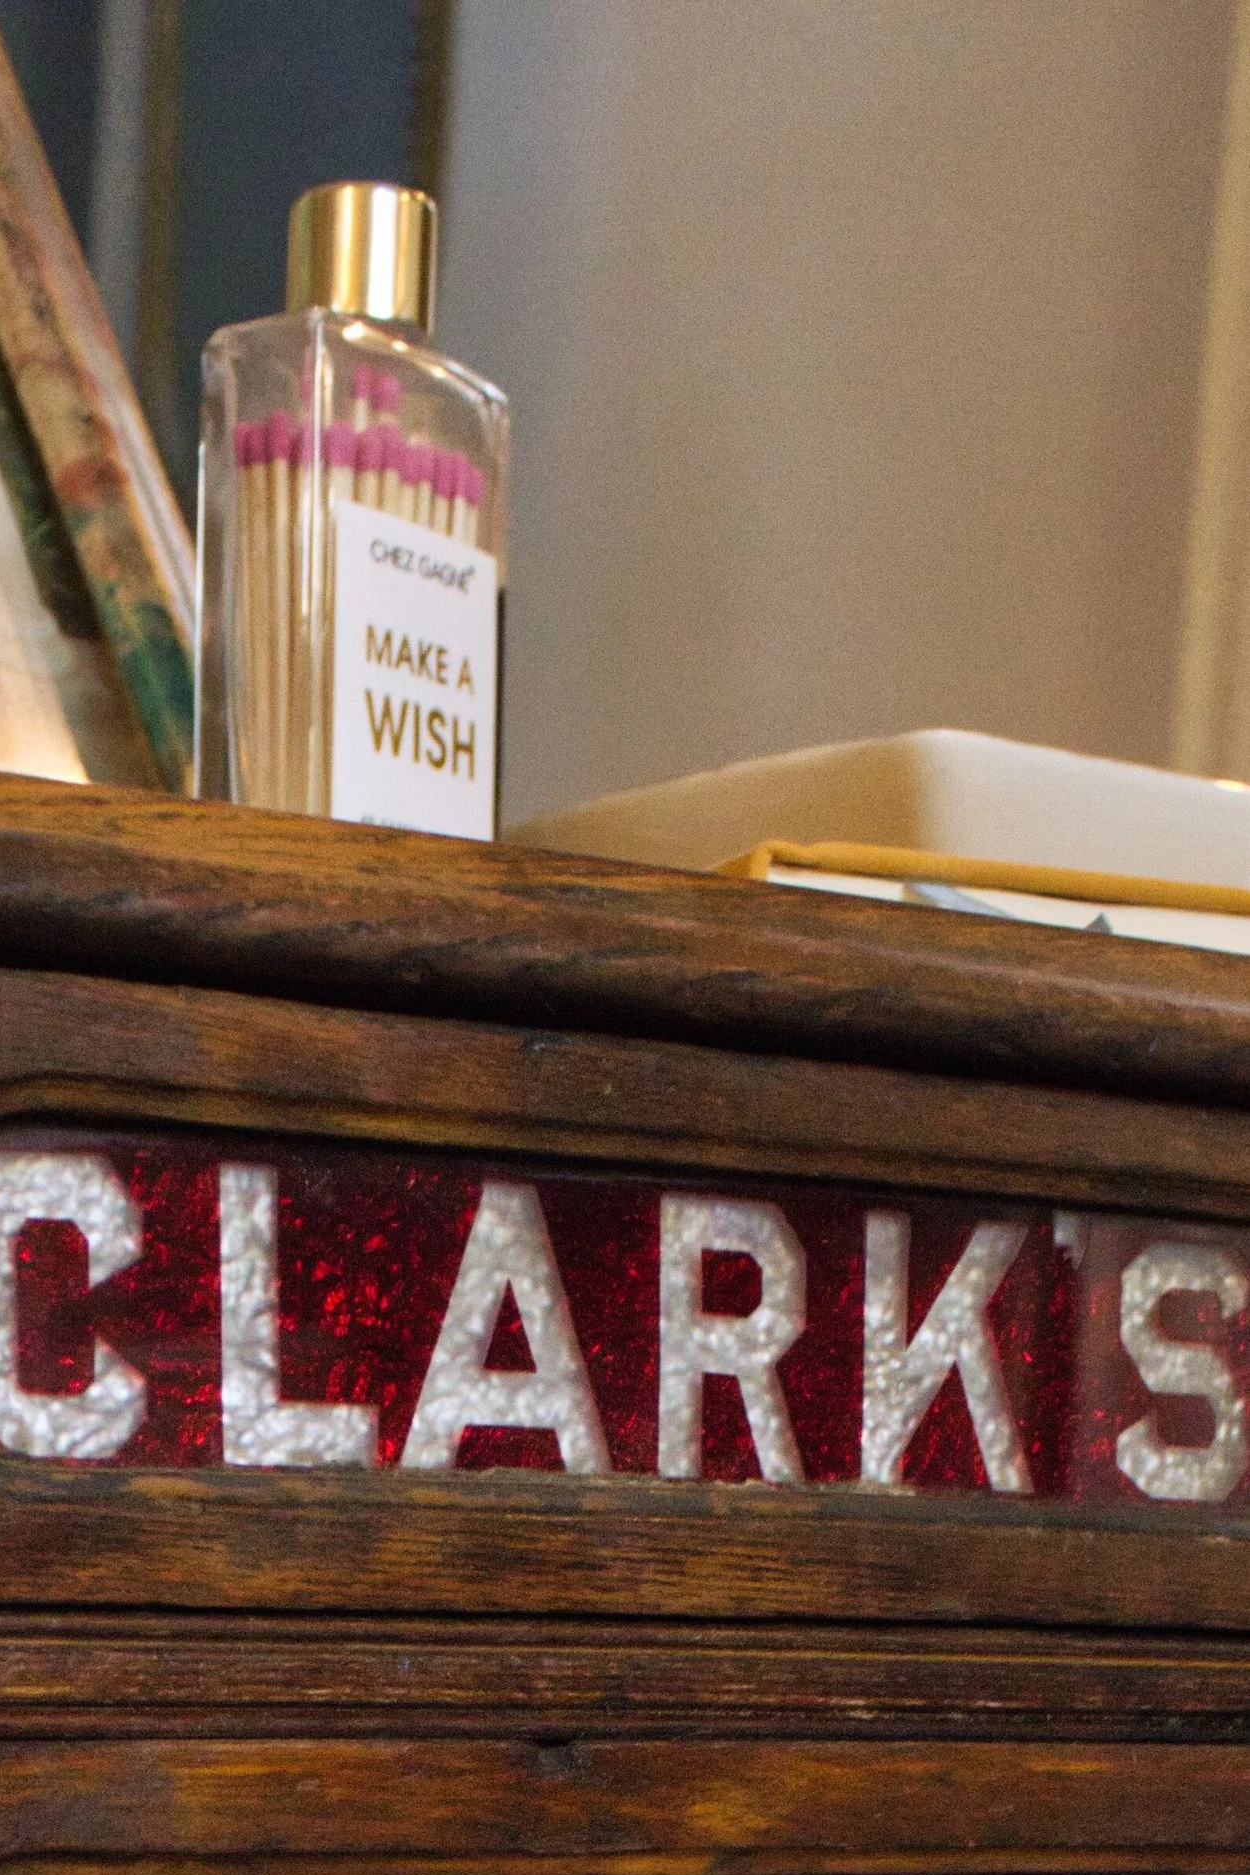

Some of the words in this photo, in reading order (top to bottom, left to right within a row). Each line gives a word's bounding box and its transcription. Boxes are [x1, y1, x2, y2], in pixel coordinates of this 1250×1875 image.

[366, 623, 448, 686] MAKE
[456, 656, 475, 695] A
[364, 687, 476, 781] WISH
